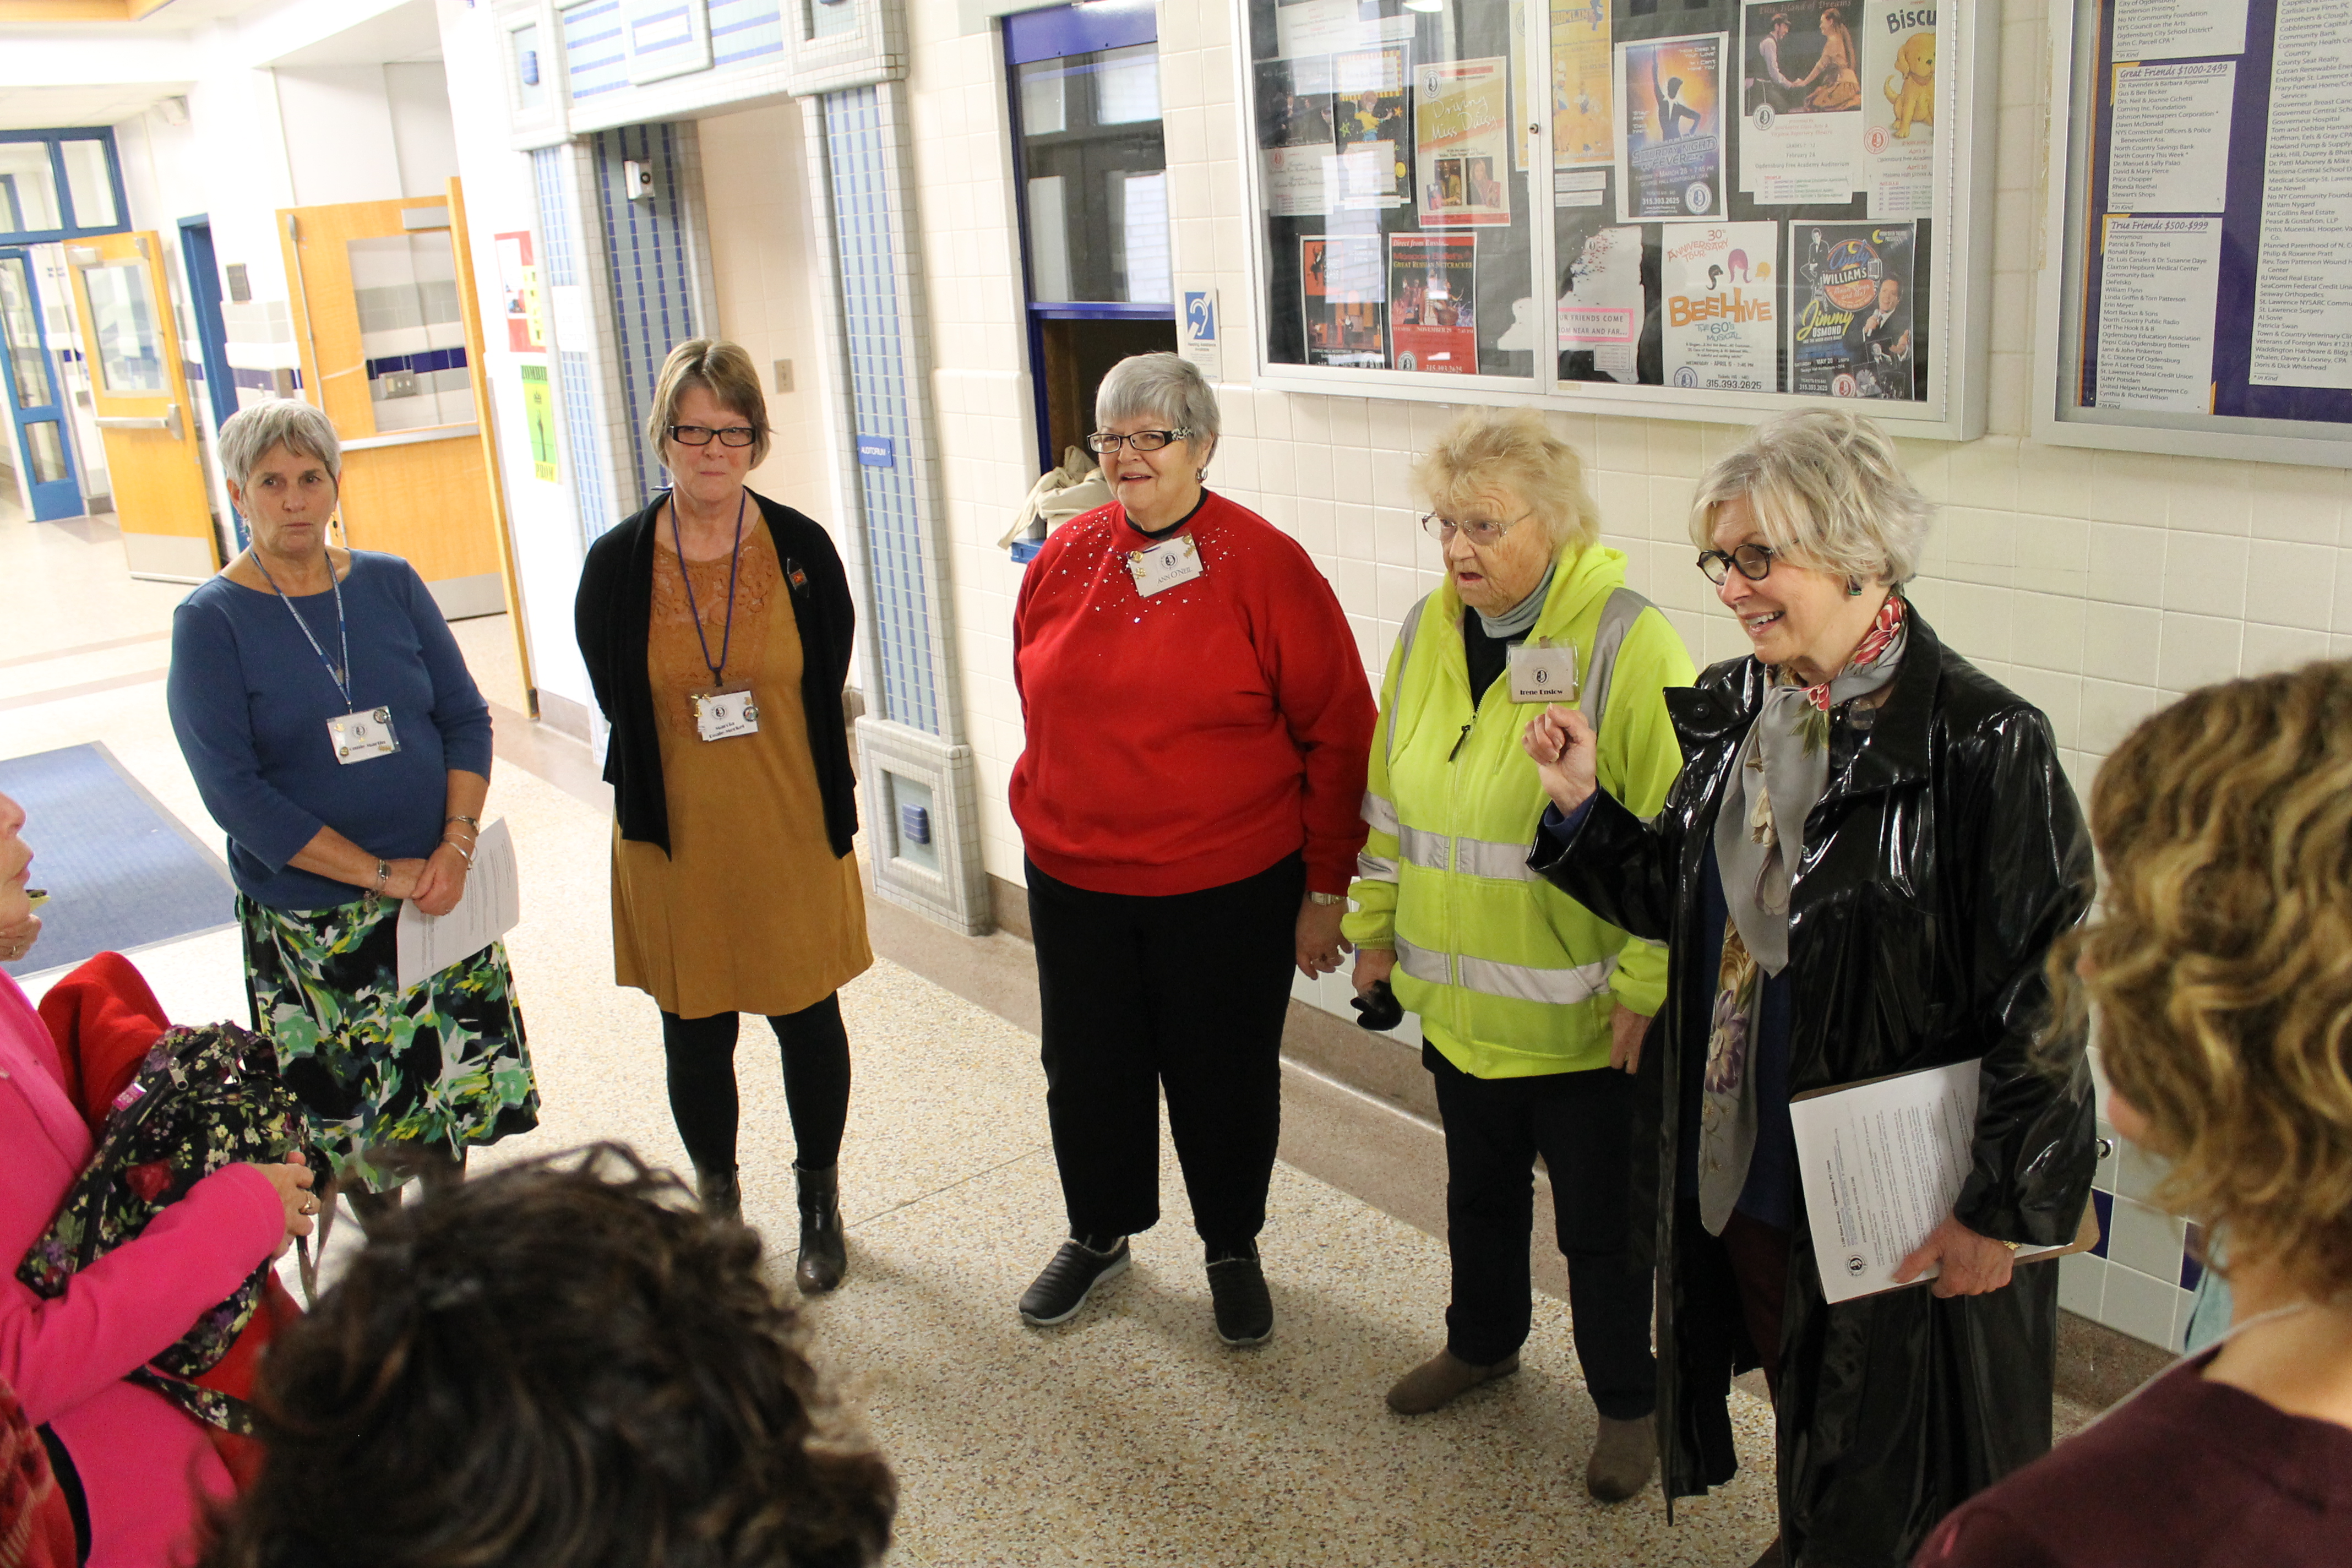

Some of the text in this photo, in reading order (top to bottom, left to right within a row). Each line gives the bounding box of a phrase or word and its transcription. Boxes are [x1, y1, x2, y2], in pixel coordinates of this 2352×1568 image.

[2116, 30, 2153, 39] Ogdensburg
[2120, 64, 2228, 78] Great Friends $1000-2499
[1430, 95, 1498, 143] Driving Miss Daisy
[2142, 112, 2177, 121] Newspapers
[2178, 111, 2214, 119] Corporation
[1683, 139, 1714, 151] NIGHT
[1653, 154, 1686, 168] FEVER
[2111, 220, 2208, 230] True Friends $500-$999
[1410, 239, 1424, 248] from
[1668, 238, 1728, 262] ANNIVERSARY
[1683, 250, 1706, 262] TOUR
[1822, 267, 1867, 285] WILLIAMS
[1796, 300, 1854, 341] Jimmy
[1695, 324, 1709, 333] THE
[1812, 325, 1842, 337] OSMOND
[1706, 331, 1741, 341] MUSICAL
[1706, 379, 1762, 389] 315.393.2625
[2142, 385, 2179, 394] Management
[535, 464, 553, 480] PROM
[1157, 574, 1171, 584] ANN
